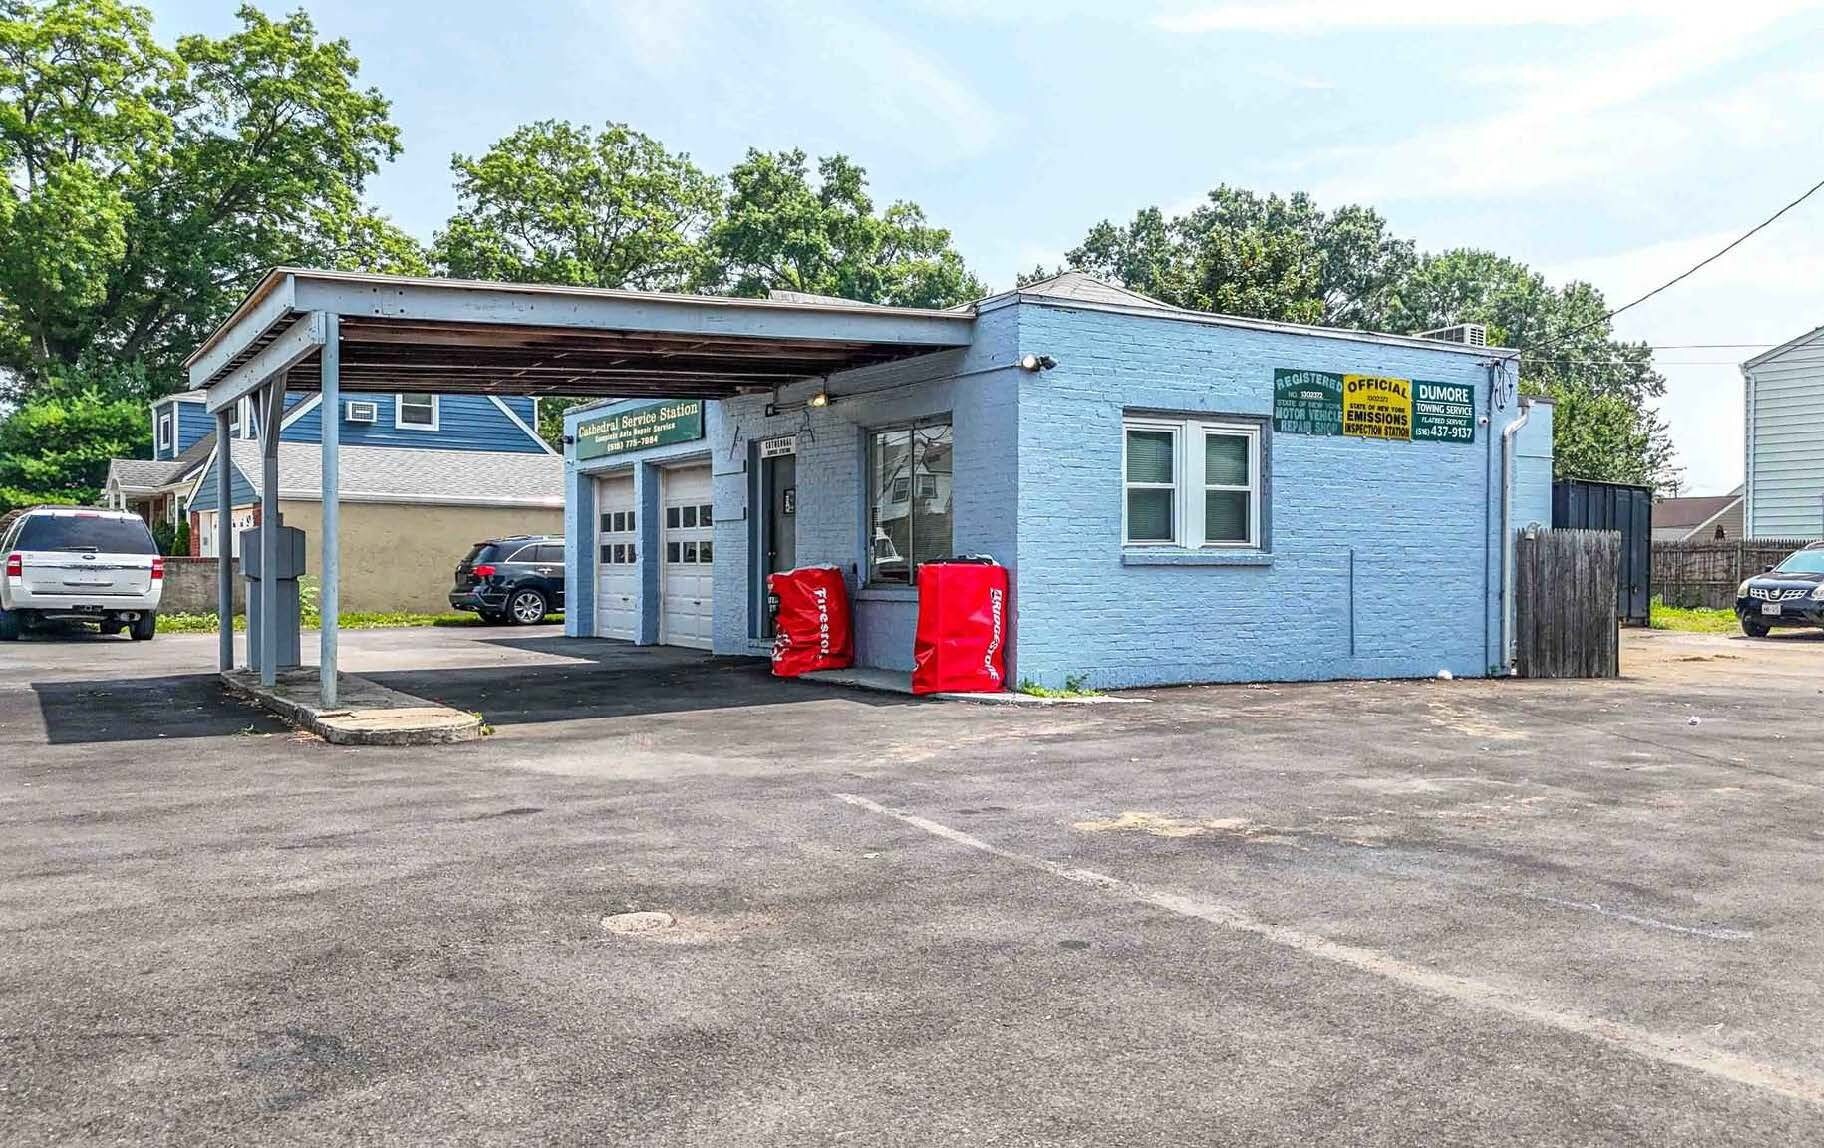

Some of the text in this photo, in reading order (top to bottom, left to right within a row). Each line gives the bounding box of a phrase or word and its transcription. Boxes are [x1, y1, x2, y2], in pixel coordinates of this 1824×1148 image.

[1276, 372, 1342, 392] REGISTERED
[1348, 378, 1407, 399] OFFICIAL
[1419, 384, 1469, 403] DUMORE
[1276, 407, 1343, 422] MOTOR VEHICLE
[1416, 403, 1473, 416] TOWING SERVICE
[578, 403, 698, 438] Cathedral Service Station
[1347, 410, 1407, 426] EMISSIONS
[1421, 416, 1467, 426] FLATBED SERVICE
[633, 427, 652, 436] Repair
[653, 422, 676, 433] Service
[1281, 420, 1338, 434] REPAIR SHOP
[1345, 423, 1409, 437] INSPECTION STATION
[1430, 425, 1473, 438] 437-9137
